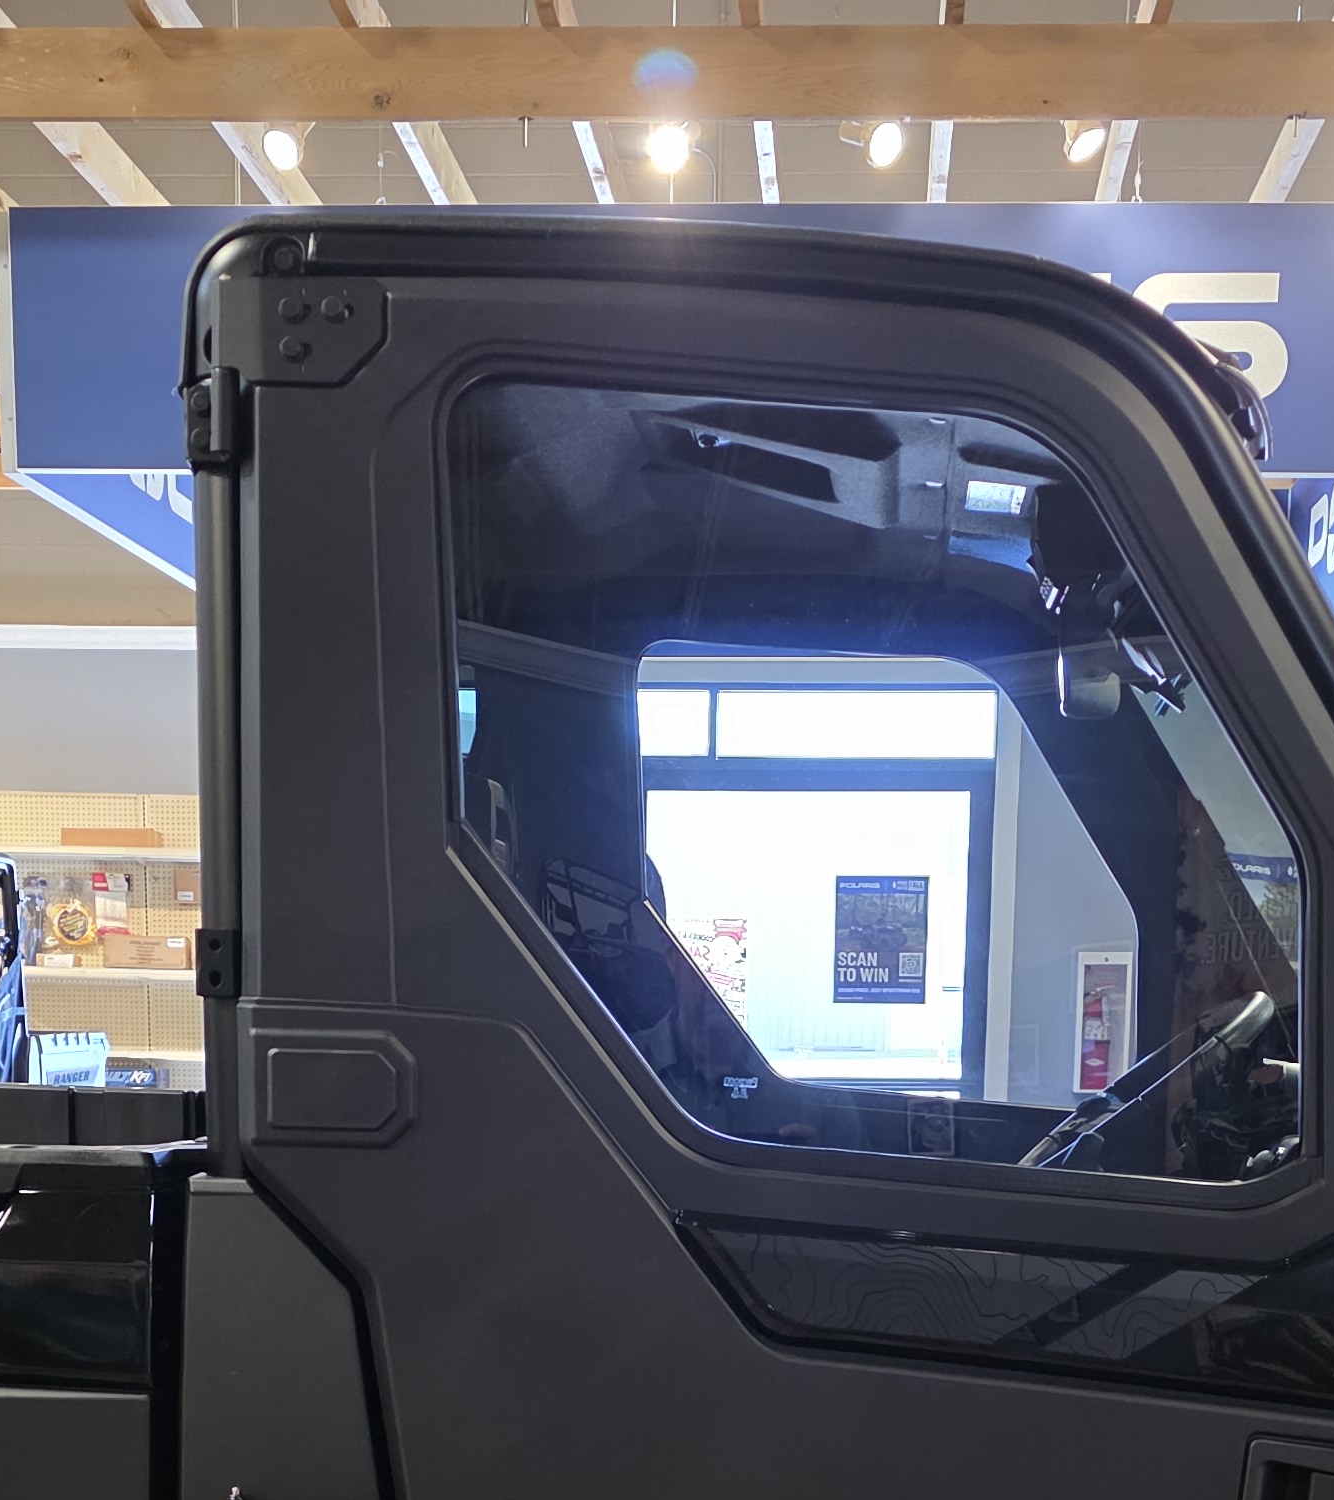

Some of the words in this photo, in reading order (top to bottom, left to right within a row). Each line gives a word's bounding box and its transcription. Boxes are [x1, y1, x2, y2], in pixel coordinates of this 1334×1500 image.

[1232, 863, 1271, 875] OLARIS
[837, 952, 878, 967] SCAN
[837, 968, 856, 983] TO
[860, 967, 889, 983] WIN
[53, 1070, 91, 1085] RANGER
